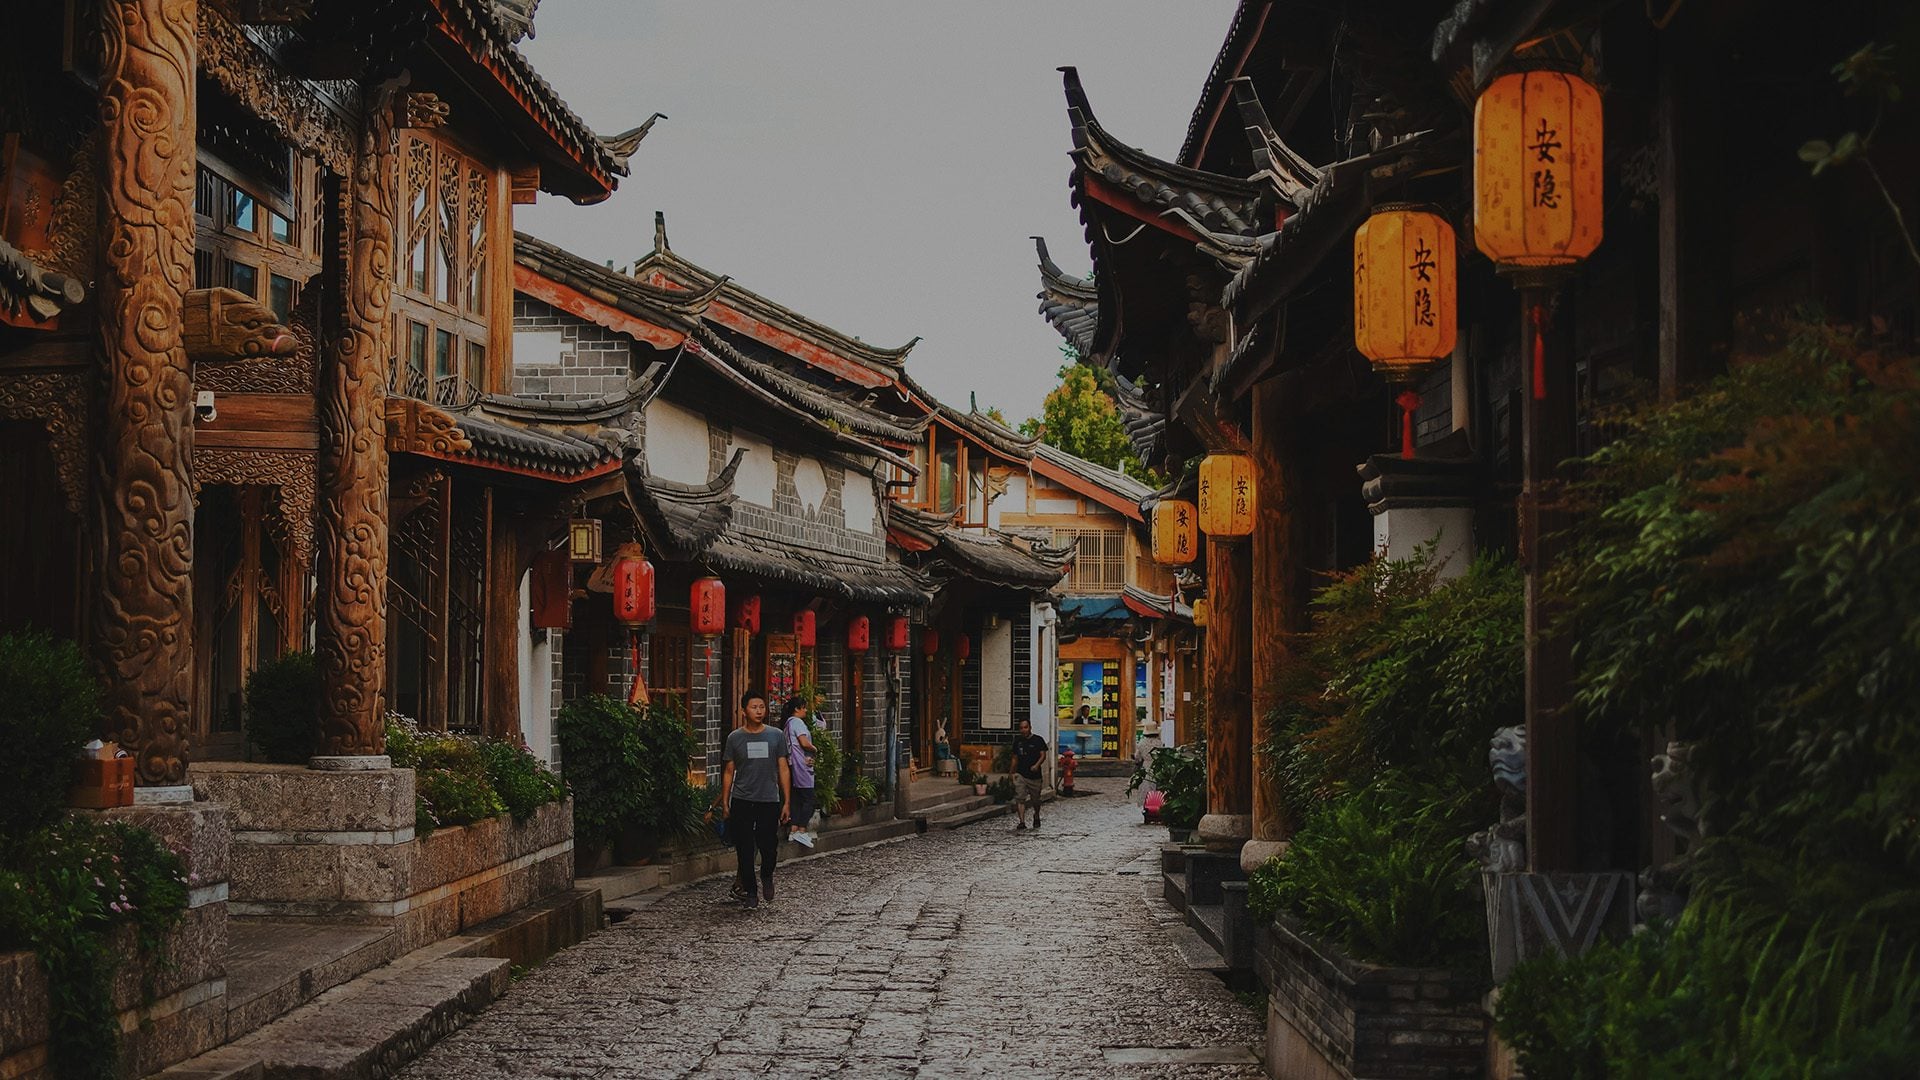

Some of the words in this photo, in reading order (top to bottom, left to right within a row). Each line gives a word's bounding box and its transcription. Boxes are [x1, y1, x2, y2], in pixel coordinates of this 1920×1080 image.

[1528, 118, 1563, 210] 安隐
[1409, 238, 1436, 328] 安隐
[1234, 475, 1249, 516] 安隐
[1176, 508, 1189, 555] 安隐
